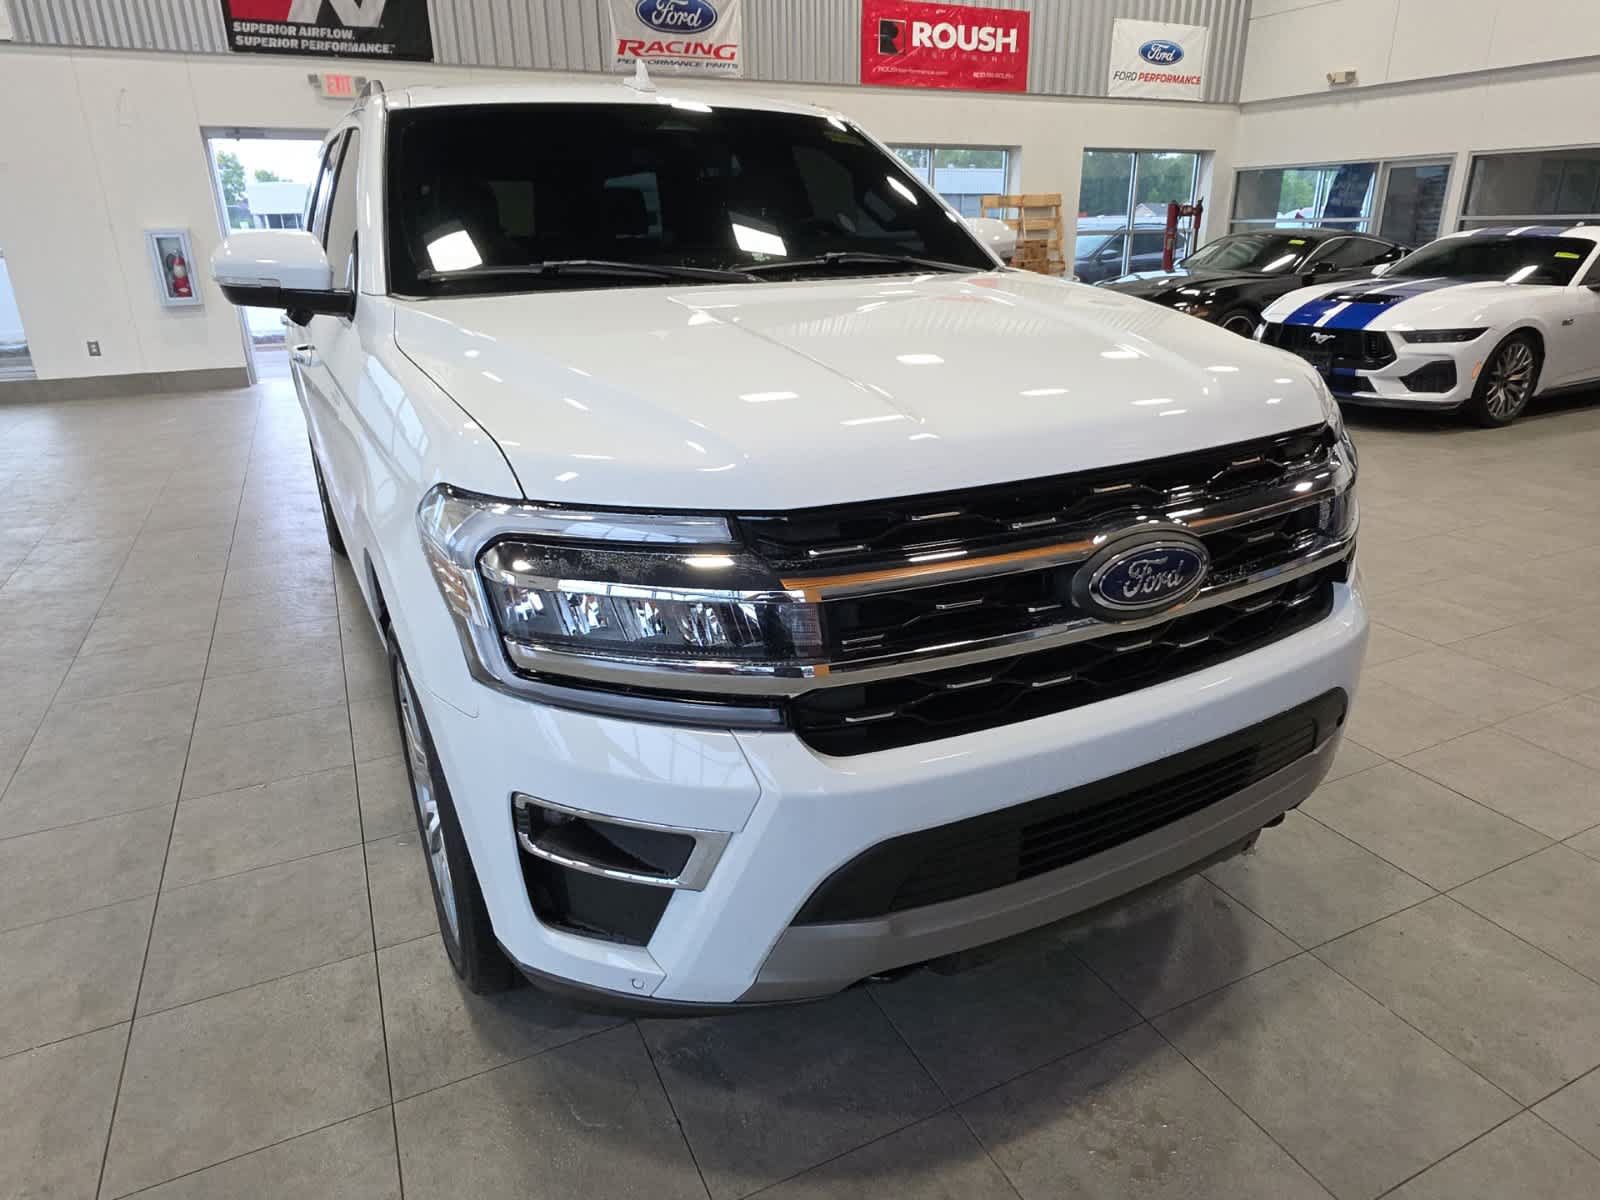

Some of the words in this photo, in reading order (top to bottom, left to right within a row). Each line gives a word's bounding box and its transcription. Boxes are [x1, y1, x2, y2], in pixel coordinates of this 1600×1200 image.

[652, 0, 702, 26] Ford
[233, 21, 296, 36] SUPERIOR
[298, 26, 355, 40] AIRFLOW.
[912, 21, 1018, 53] ROUSH
[235, 35, 299, 49] SUPERIOR
[617, 38, 737, 60] RACING
[1147, 43, 1176, 61] Ford
[617, 58, 703, 68] PEORMANCE
[705, 61, 738, 69] PARTS
[1113, 70, 1138, 81] FORD
[1138, 72, 1201, 85] PERFORMANCE
[1123, 556, 1185, 598] Ford
